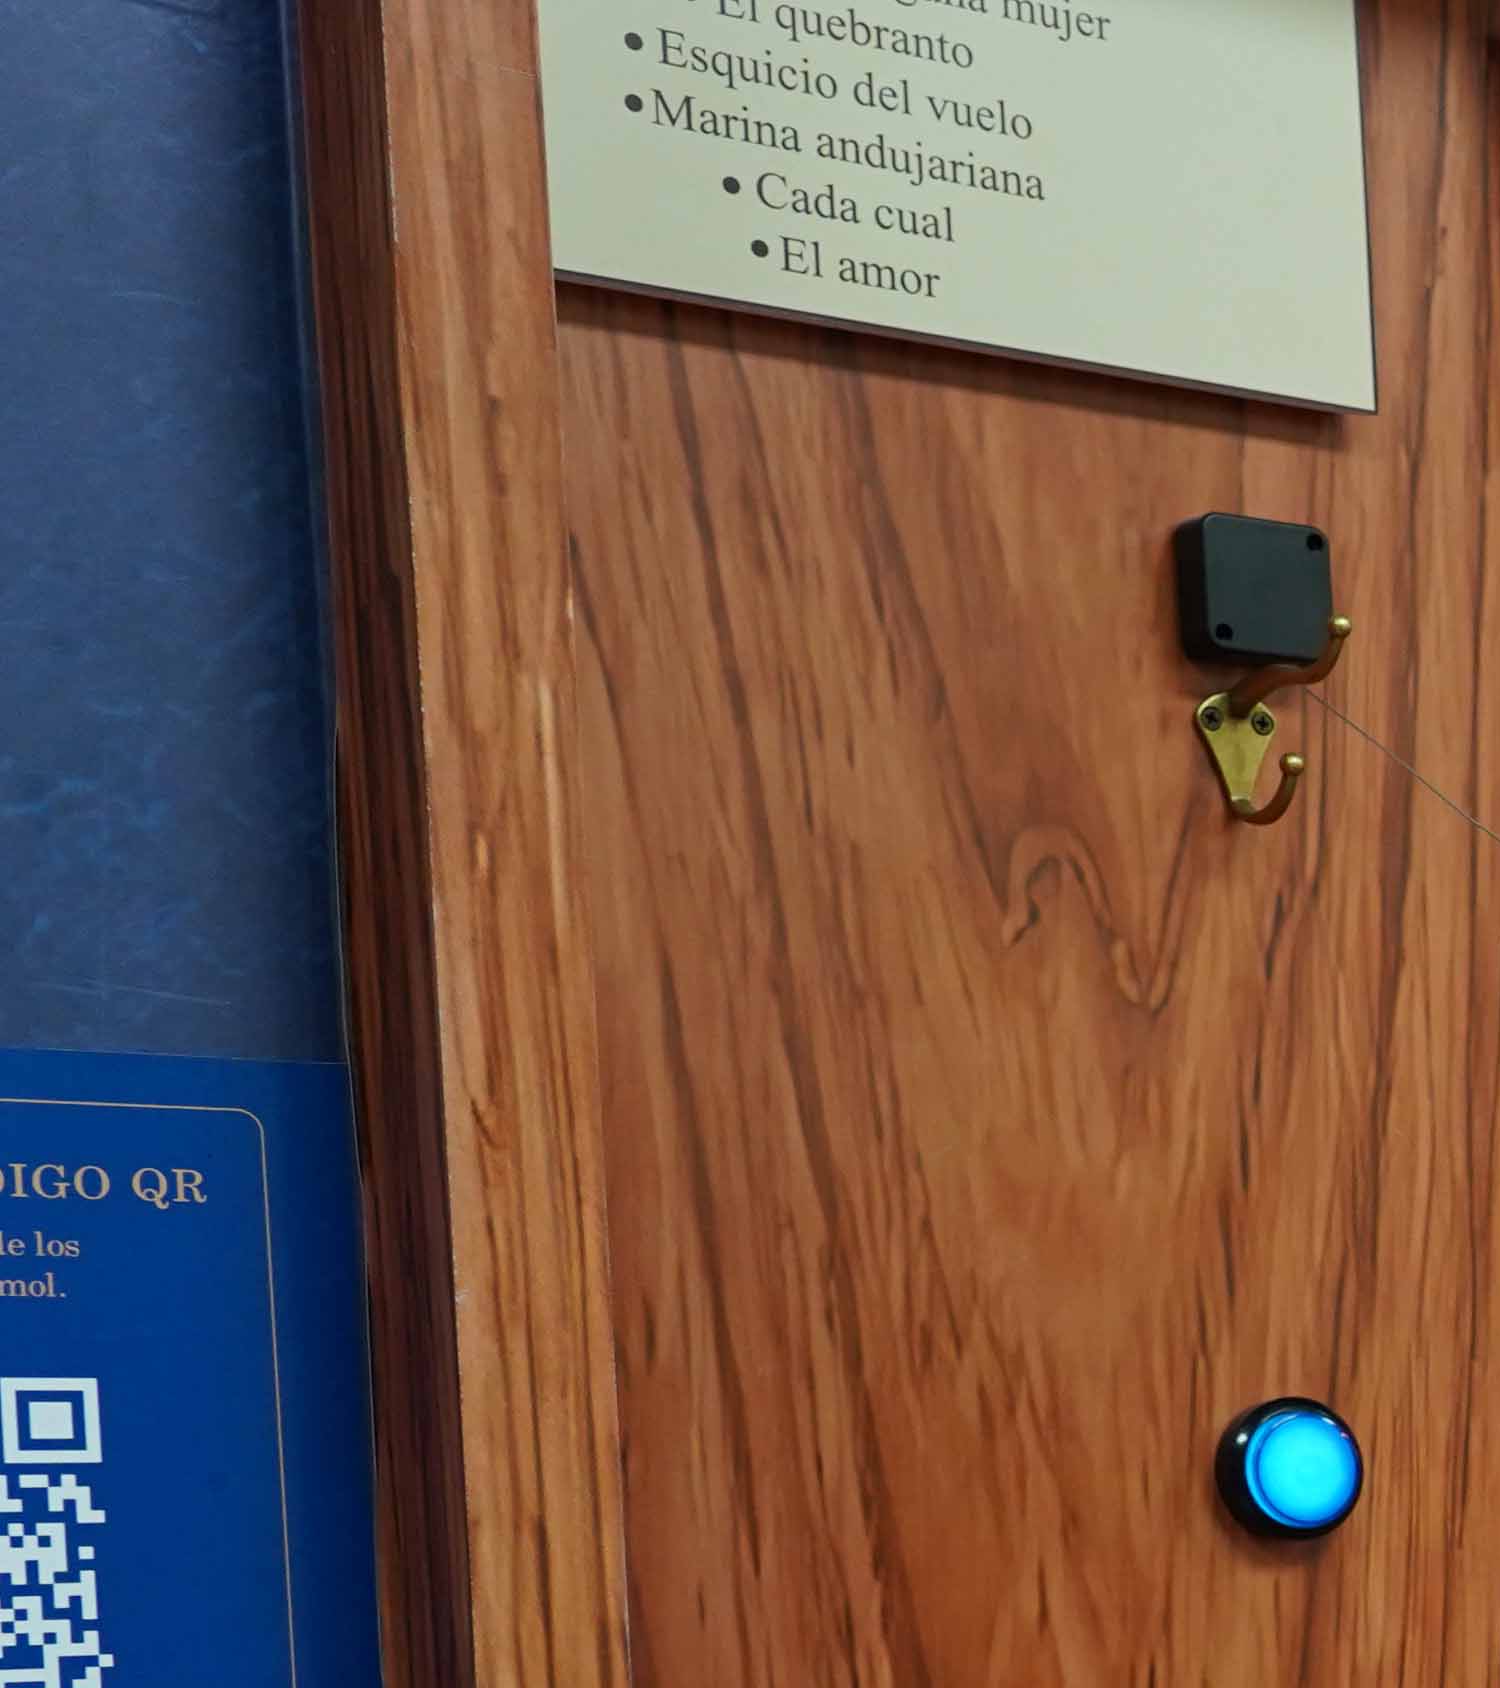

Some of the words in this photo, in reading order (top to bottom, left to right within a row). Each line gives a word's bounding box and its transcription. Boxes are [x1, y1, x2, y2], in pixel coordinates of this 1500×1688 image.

[775, 3, 975, 69] quebranto
[1003, 0, 1111, 42] mujer
[657, 27, 838, 100] Esquicio
[852, 71, 912, 116] del
[925, 95, 1033, 140] vuelo
[650, 87, 803, 153] Marina
[815, 132, 1046, 201] andujariana
[755, 171, 861, 225] Cada
[873, 204, 955, 243] cual
[778, 234, 824, 279] El
[838, 257, 941, 298] amor
[0, 1162, 111, 1200] IGO
[130, 1167, 208, 1210] QR
[33, 1231, 81, 1258] los
